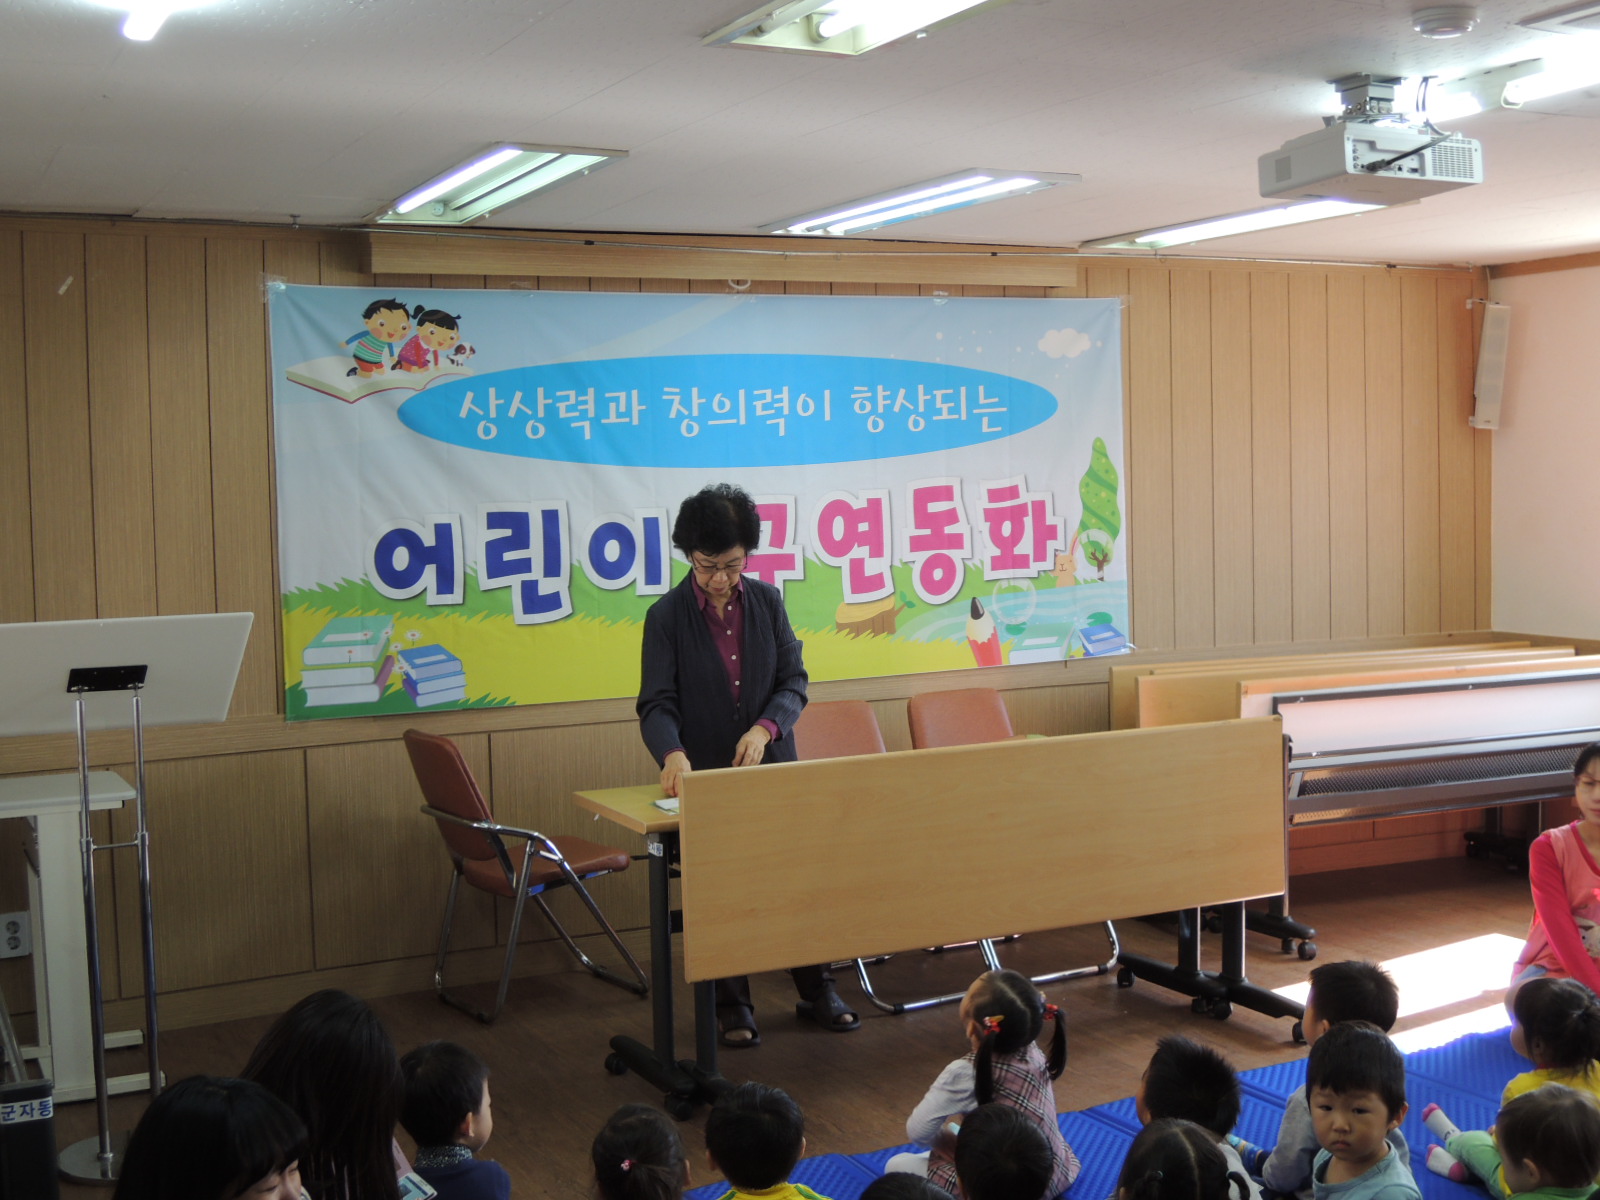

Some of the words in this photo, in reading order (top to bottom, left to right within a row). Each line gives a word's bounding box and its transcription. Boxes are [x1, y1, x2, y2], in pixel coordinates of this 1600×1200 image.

[458, 386, 646, 440] 상상력과
[662, 386, 831, 437] 창의력이
[851, 385, 1008, 433] 향상되는
[373, 507, 664, 616] 어린이
[1, 1100, 52, 1121] 군자동
